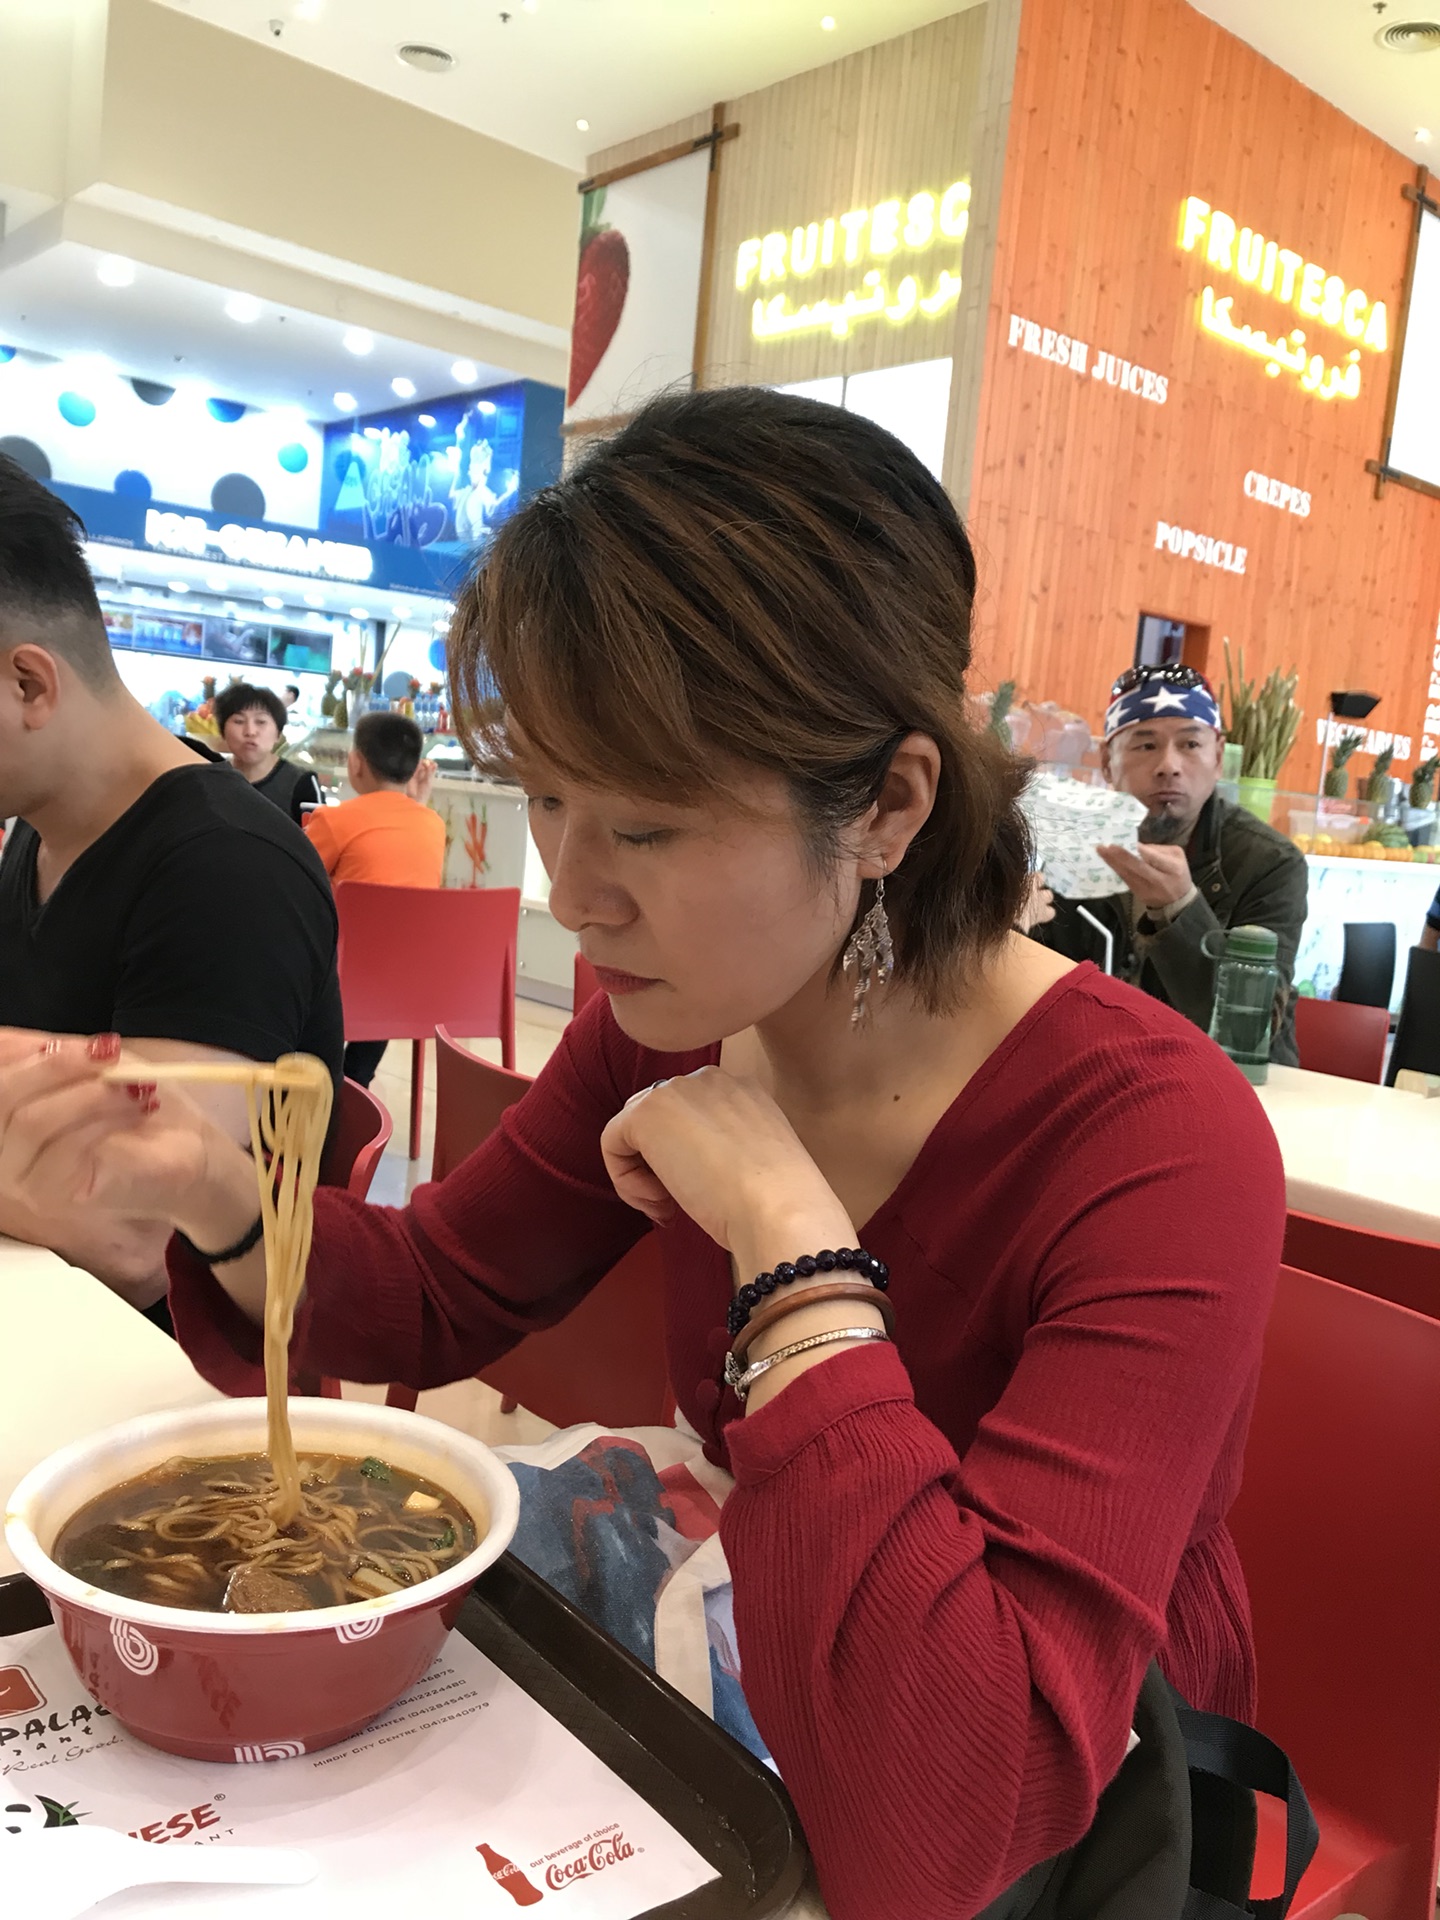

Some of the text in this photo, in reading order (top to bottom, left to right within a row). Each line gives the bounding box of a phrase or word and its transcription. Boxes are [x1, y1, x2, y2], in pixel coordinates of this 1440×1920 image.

[1179, 195, 1388, 353] FRUITESCA
[1007, 313, 1169, 405] FRESH JUICES
[1243, 469, 1312, 518] CREPES
[1154, 520, 1248, 575] POPSICLE
[312, 1752, 348, 1769] MIRDIF
[351, 1742, 375, 1755] CITY
[378, 1728, 418, 1745] CENTRE
[366, 1716, 406, 1734] CENTER
[2, 1735, 124, 1776] Real Good.
[529, 1822, 620, 1868] our beverage of choice
[545, 1831, 635, 1891] Coca-Cola
